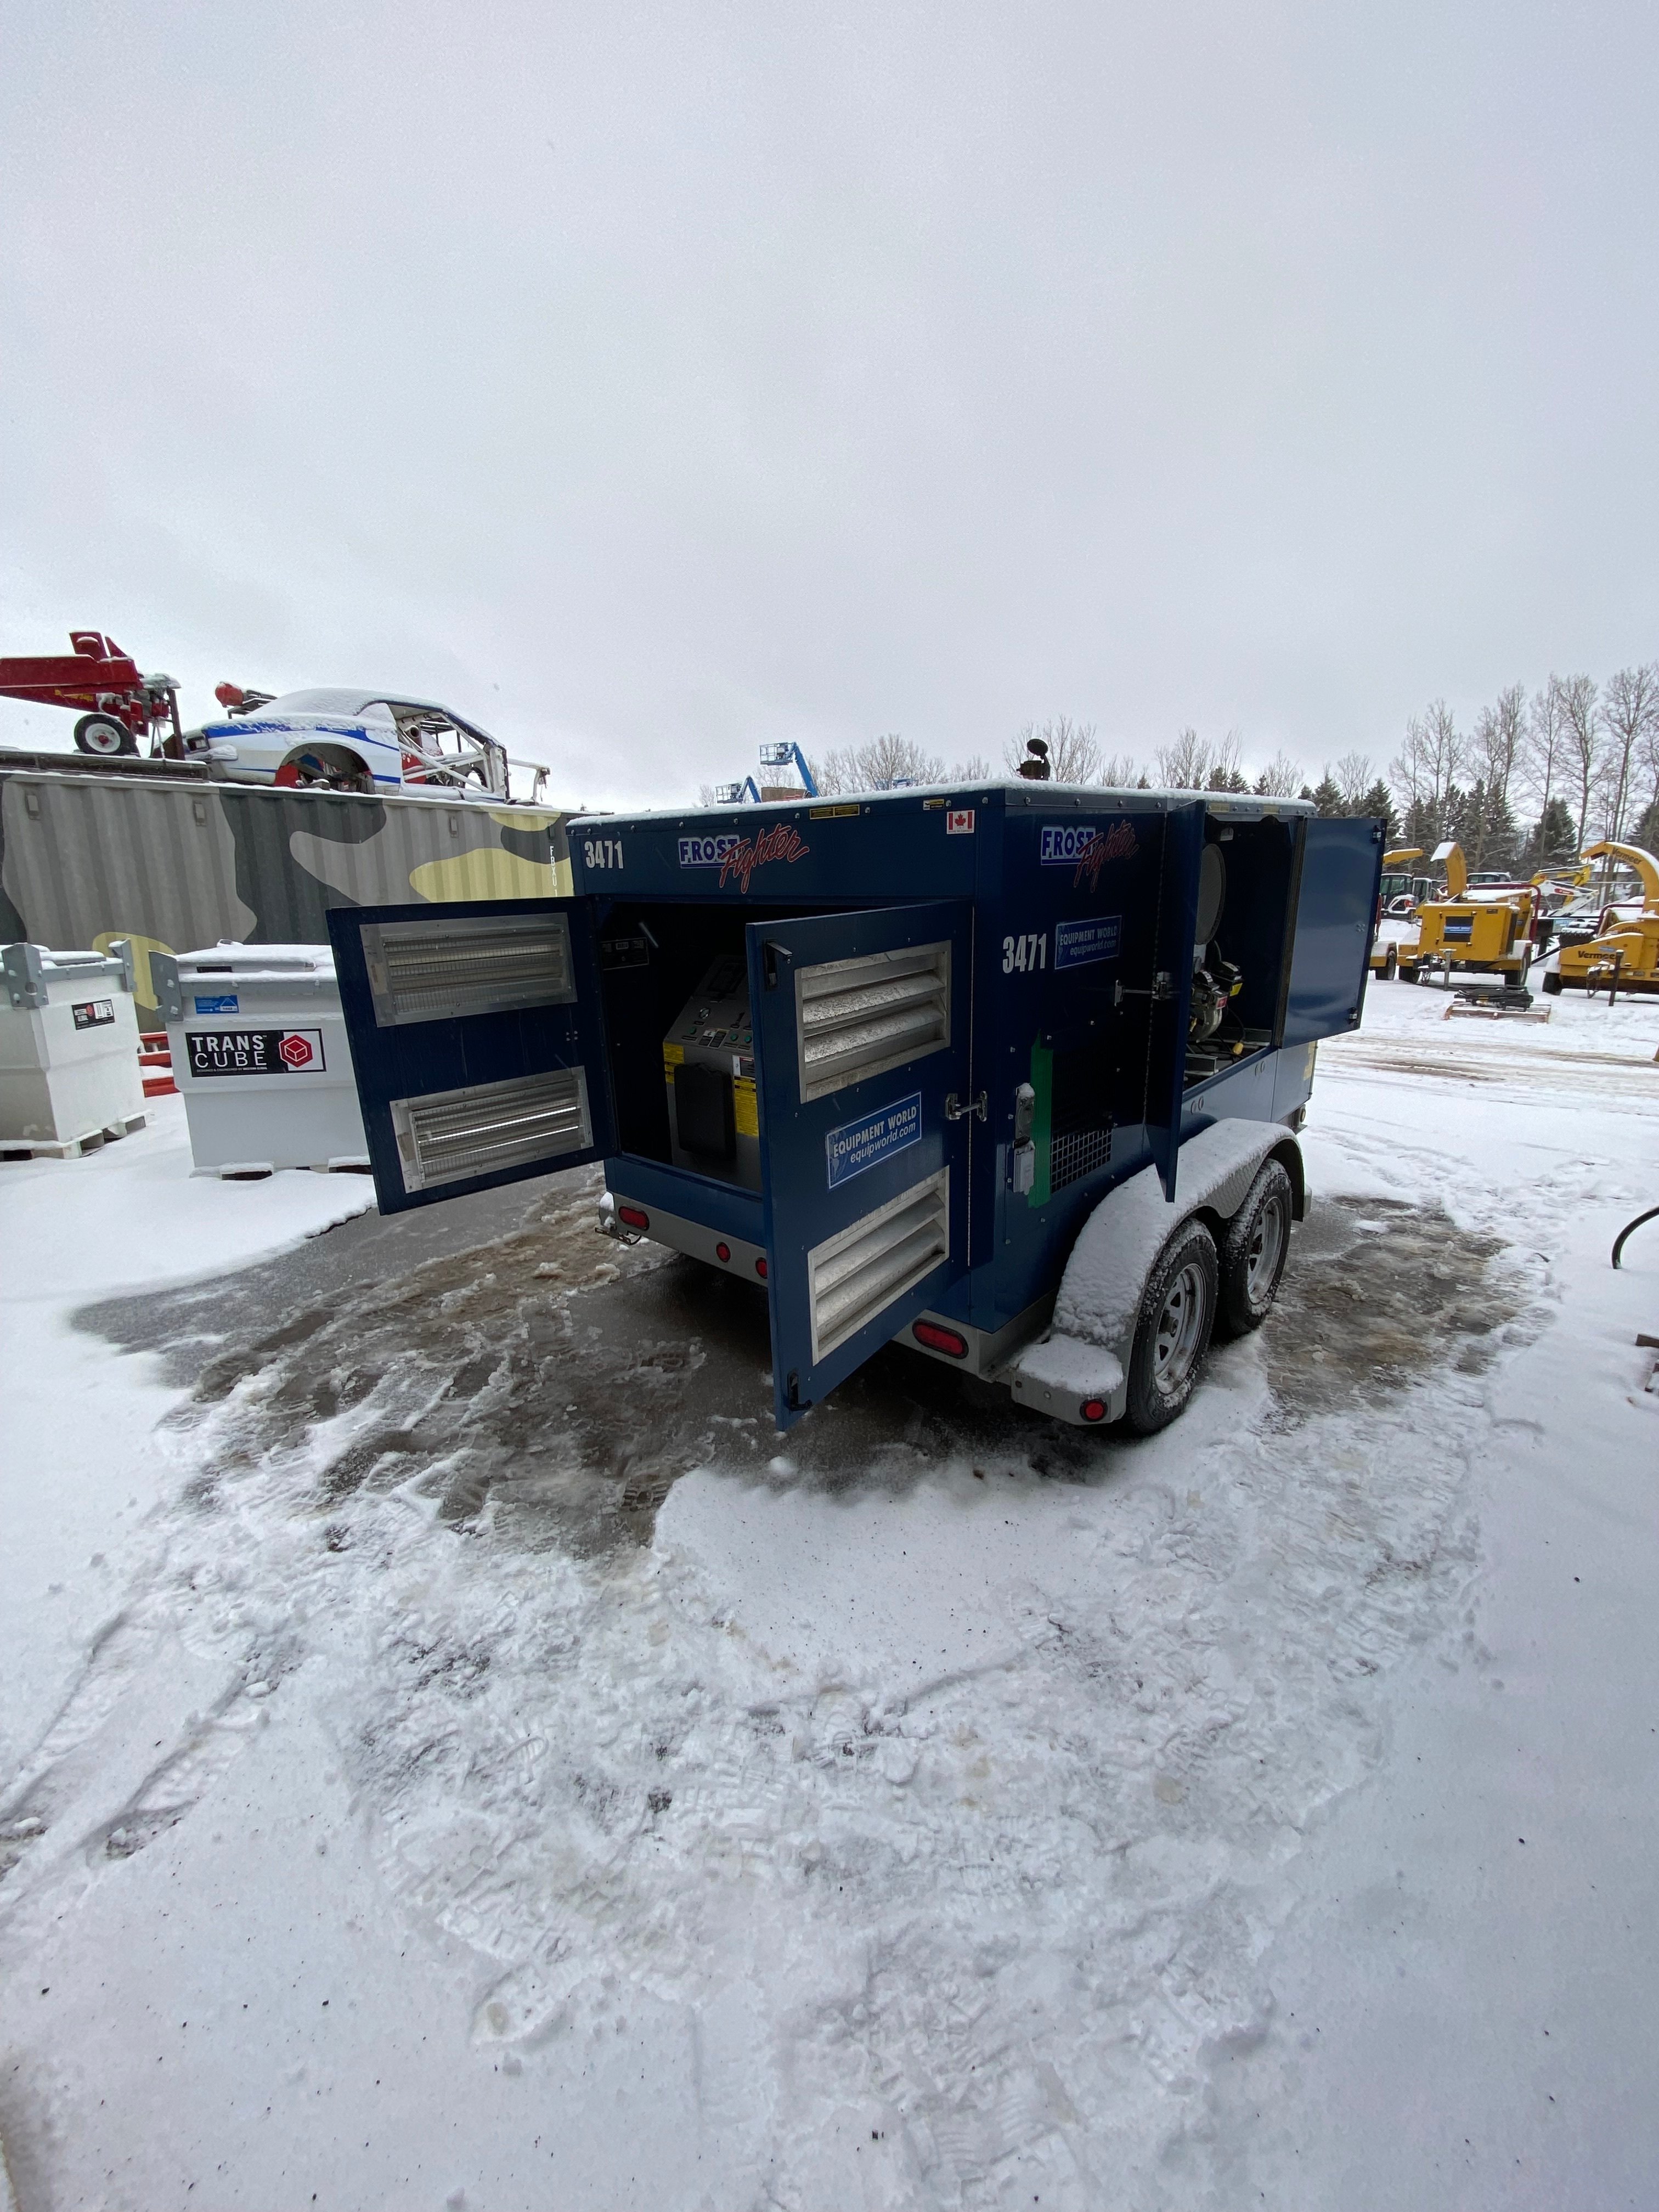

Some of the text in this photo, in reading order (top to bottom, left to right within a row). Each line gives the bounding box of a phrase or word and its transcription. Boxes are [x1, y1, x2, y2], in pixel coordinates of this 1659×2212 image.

[585, 840, 624, 869] 3471
[680, 823, 810, 894] FROST Fighter
[1042, 820, 1140, 893] FROST Fighter
[1611, 847, 1642, 865] Vermeer
[1059, 929, 1096, 946] EQUIPMENT
[1070, 940, 1116, 956] equipworld.com
[1002, 933, 1047, 974] 3471
[1578, 951, 1616, 960] Vermee
[191, 1035, 265, 1052] TRANS
[195, 1051, 267, 1068] CUBE
[833, 1106, 917, 1158] EQUIPMENT WORLD
[850, 1122, 916, 1163] equipworld.com
